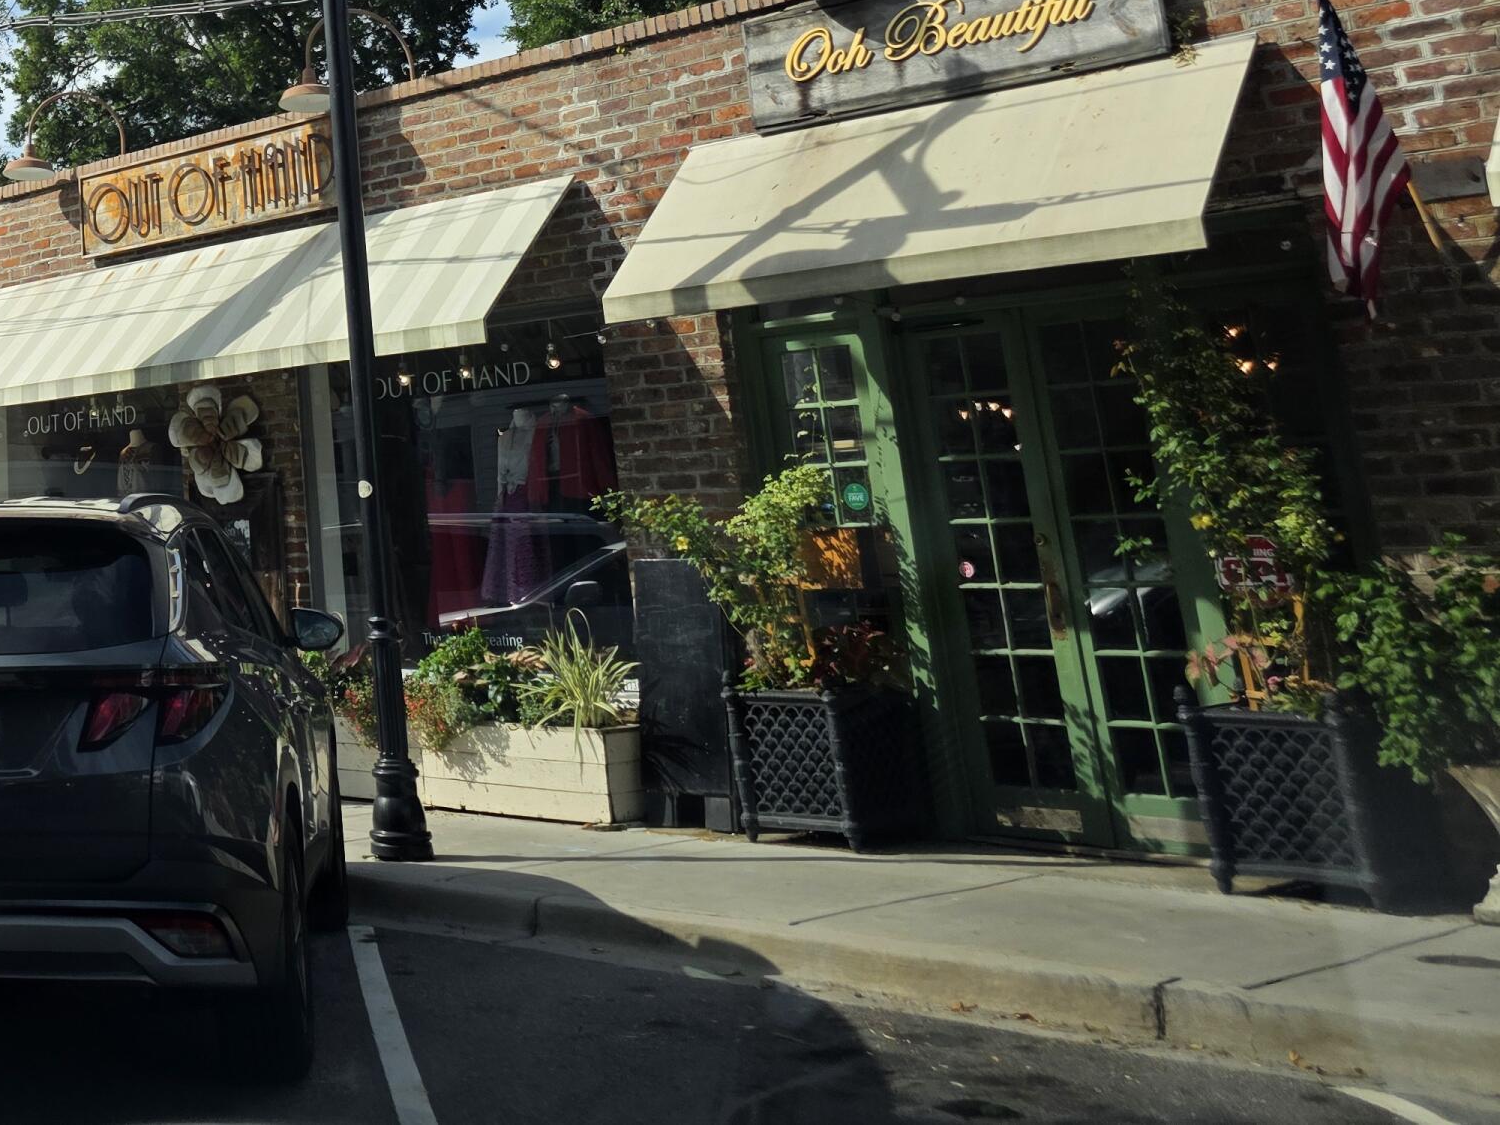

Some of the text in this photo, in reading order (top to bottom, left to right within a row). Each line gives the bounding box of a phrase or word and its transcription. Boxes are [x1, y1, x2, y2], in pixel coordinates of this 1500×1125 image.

[785, 27, 875, 82] Ooh
[87, 133, 335, 244] OUT OF HAND
[422, 370, 451, 394] OF
[460, 361, 530, 391] HAND
[27, 405, 137, 435] OUT OF HAND
[486, 633, 523, 650] reating
